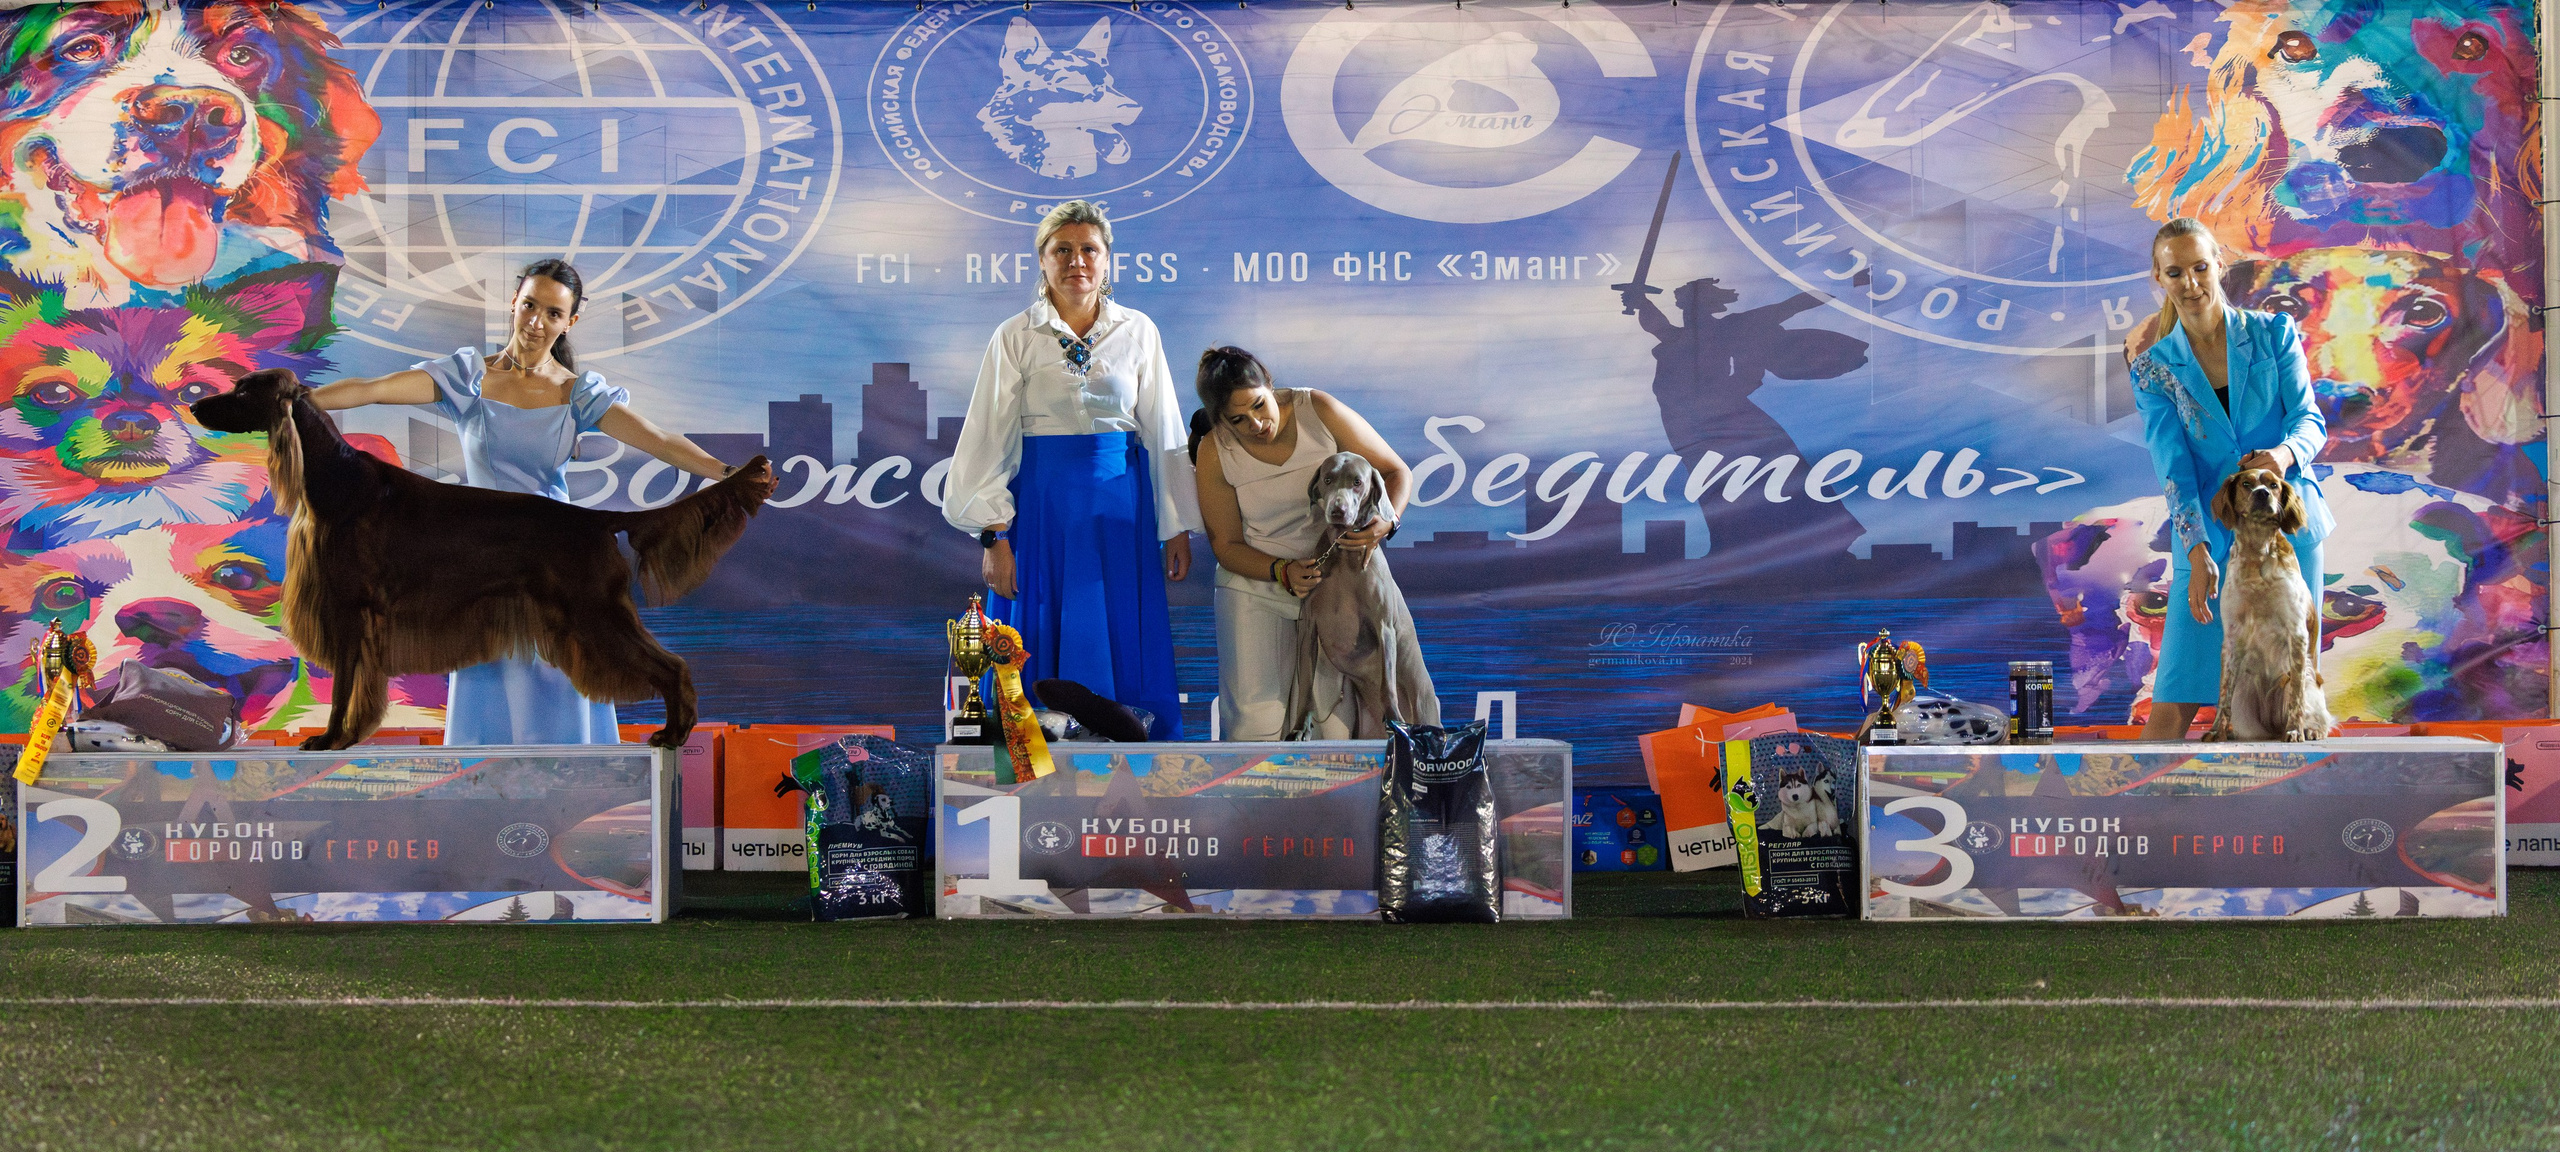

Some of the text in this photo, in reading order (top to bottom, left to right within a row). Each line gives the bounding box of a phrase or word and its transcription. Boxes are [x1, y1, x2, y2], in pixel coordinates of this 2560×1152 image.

[881, 65, 944, 180] РОССИЙСКАЯ
[1175, 30, 1238, 178] СОБАКОВОДСТВА
[408, 117, 619, 173] FCI
[614, 2, 815, 331] INTERNATIONALE
[1717, 49, 2010, 331] РОССИЙСКАЯ
[857, 250, 1622, 283] FCI RKF FSS МОО ФКС «Эманг»
[1413, 757, 1474, 773] KORWOOD
[165, 822, 276, 838] КУБОК
[1081, 818, 1191, 834] КУБОК
[2010, 817, 2120, 833] КУБОК
[33, 799, 128, 893] 2
[168, 840, 304, 863] ГОРОДОВ
[326, 840, 440, 860] ГЕРОЕВ
[731, 841, 805, 858] четыре
[863, 849, 897, 857] ВЗРОСЛЫХ
[957, 796, 1048, 895] 1
[1084, 836, 1219, 856] ГОРОДОВ
[1678, 836, 1738, 857] четыр
[1879, 796, 1975, 896] 3
[2013, 836, 2149, 856] ГОРОДОВ
[2173, 835, 2284, 855] ГЕРОЕВ
[866, 855, 896, 863] СРЕДНИХ
[869, 861, 914, 871] ГОВЯДИНОЙ
[858, 892, 867, 905] 3
[1801, 891, 1810, 904] 3
